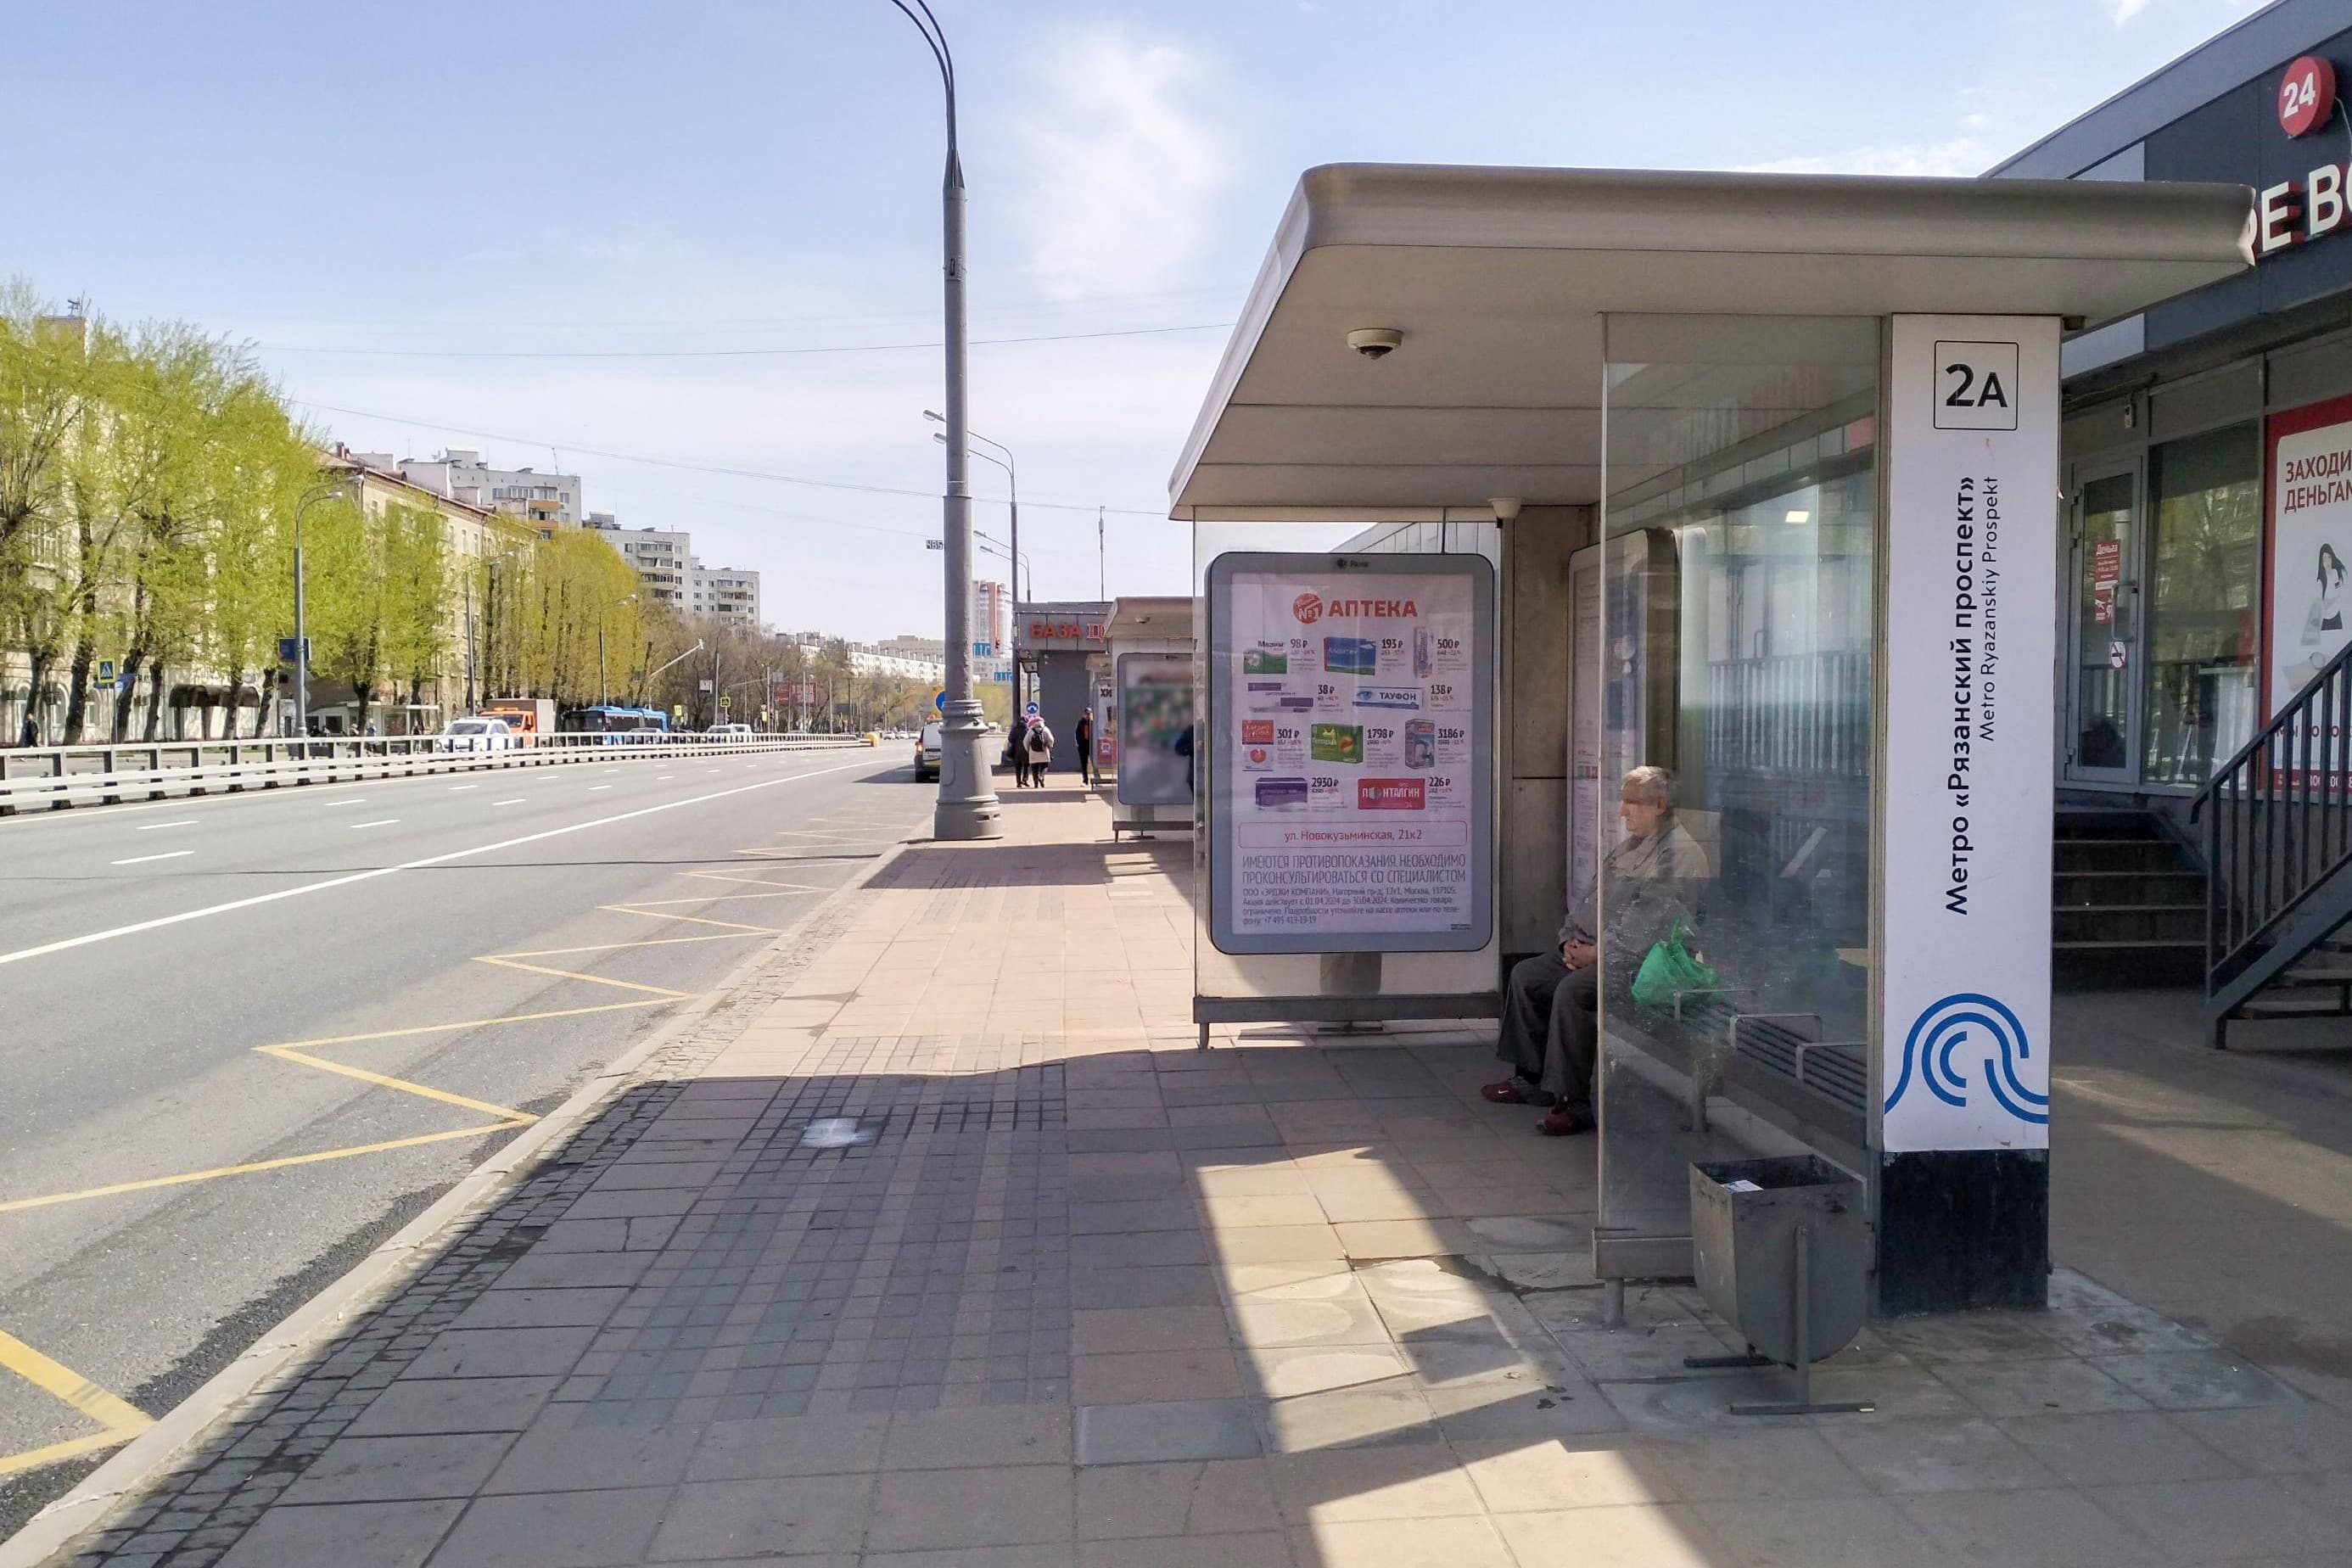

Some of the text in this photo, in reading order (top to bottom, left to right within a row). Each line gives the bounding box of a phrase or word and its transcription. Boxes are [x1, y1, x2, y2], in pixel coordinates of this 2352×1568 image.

[2283, 72, 2316, 119] 24
[1329, 600, 1418, 618] АПТЕКА
[1980, 476, 2001, 742] Metro Ryazanskiy Prospekt
[1031, 621, 1082, 639] БАЗА
[1380, 692, 1417, 701] ТАУФОН
[1946, 477, 1978, 916] Метро «Рязанский проспект»
[1362, 787, 1420, 798] ПНТАЛГИН
[1285, 829, 1422, 843] ул. Новокузьминская, 21к2
[1242, 854, 1290, 869] ИМЕЮТСЯ
[1400, 854, 1466, 867] НЕОБХОДИМО
[1242, 869, 1465, 884] ПРОКОНСУЛЬТИРОВАТЬСЯ СО СПЕЦИАЛИСТОМ
